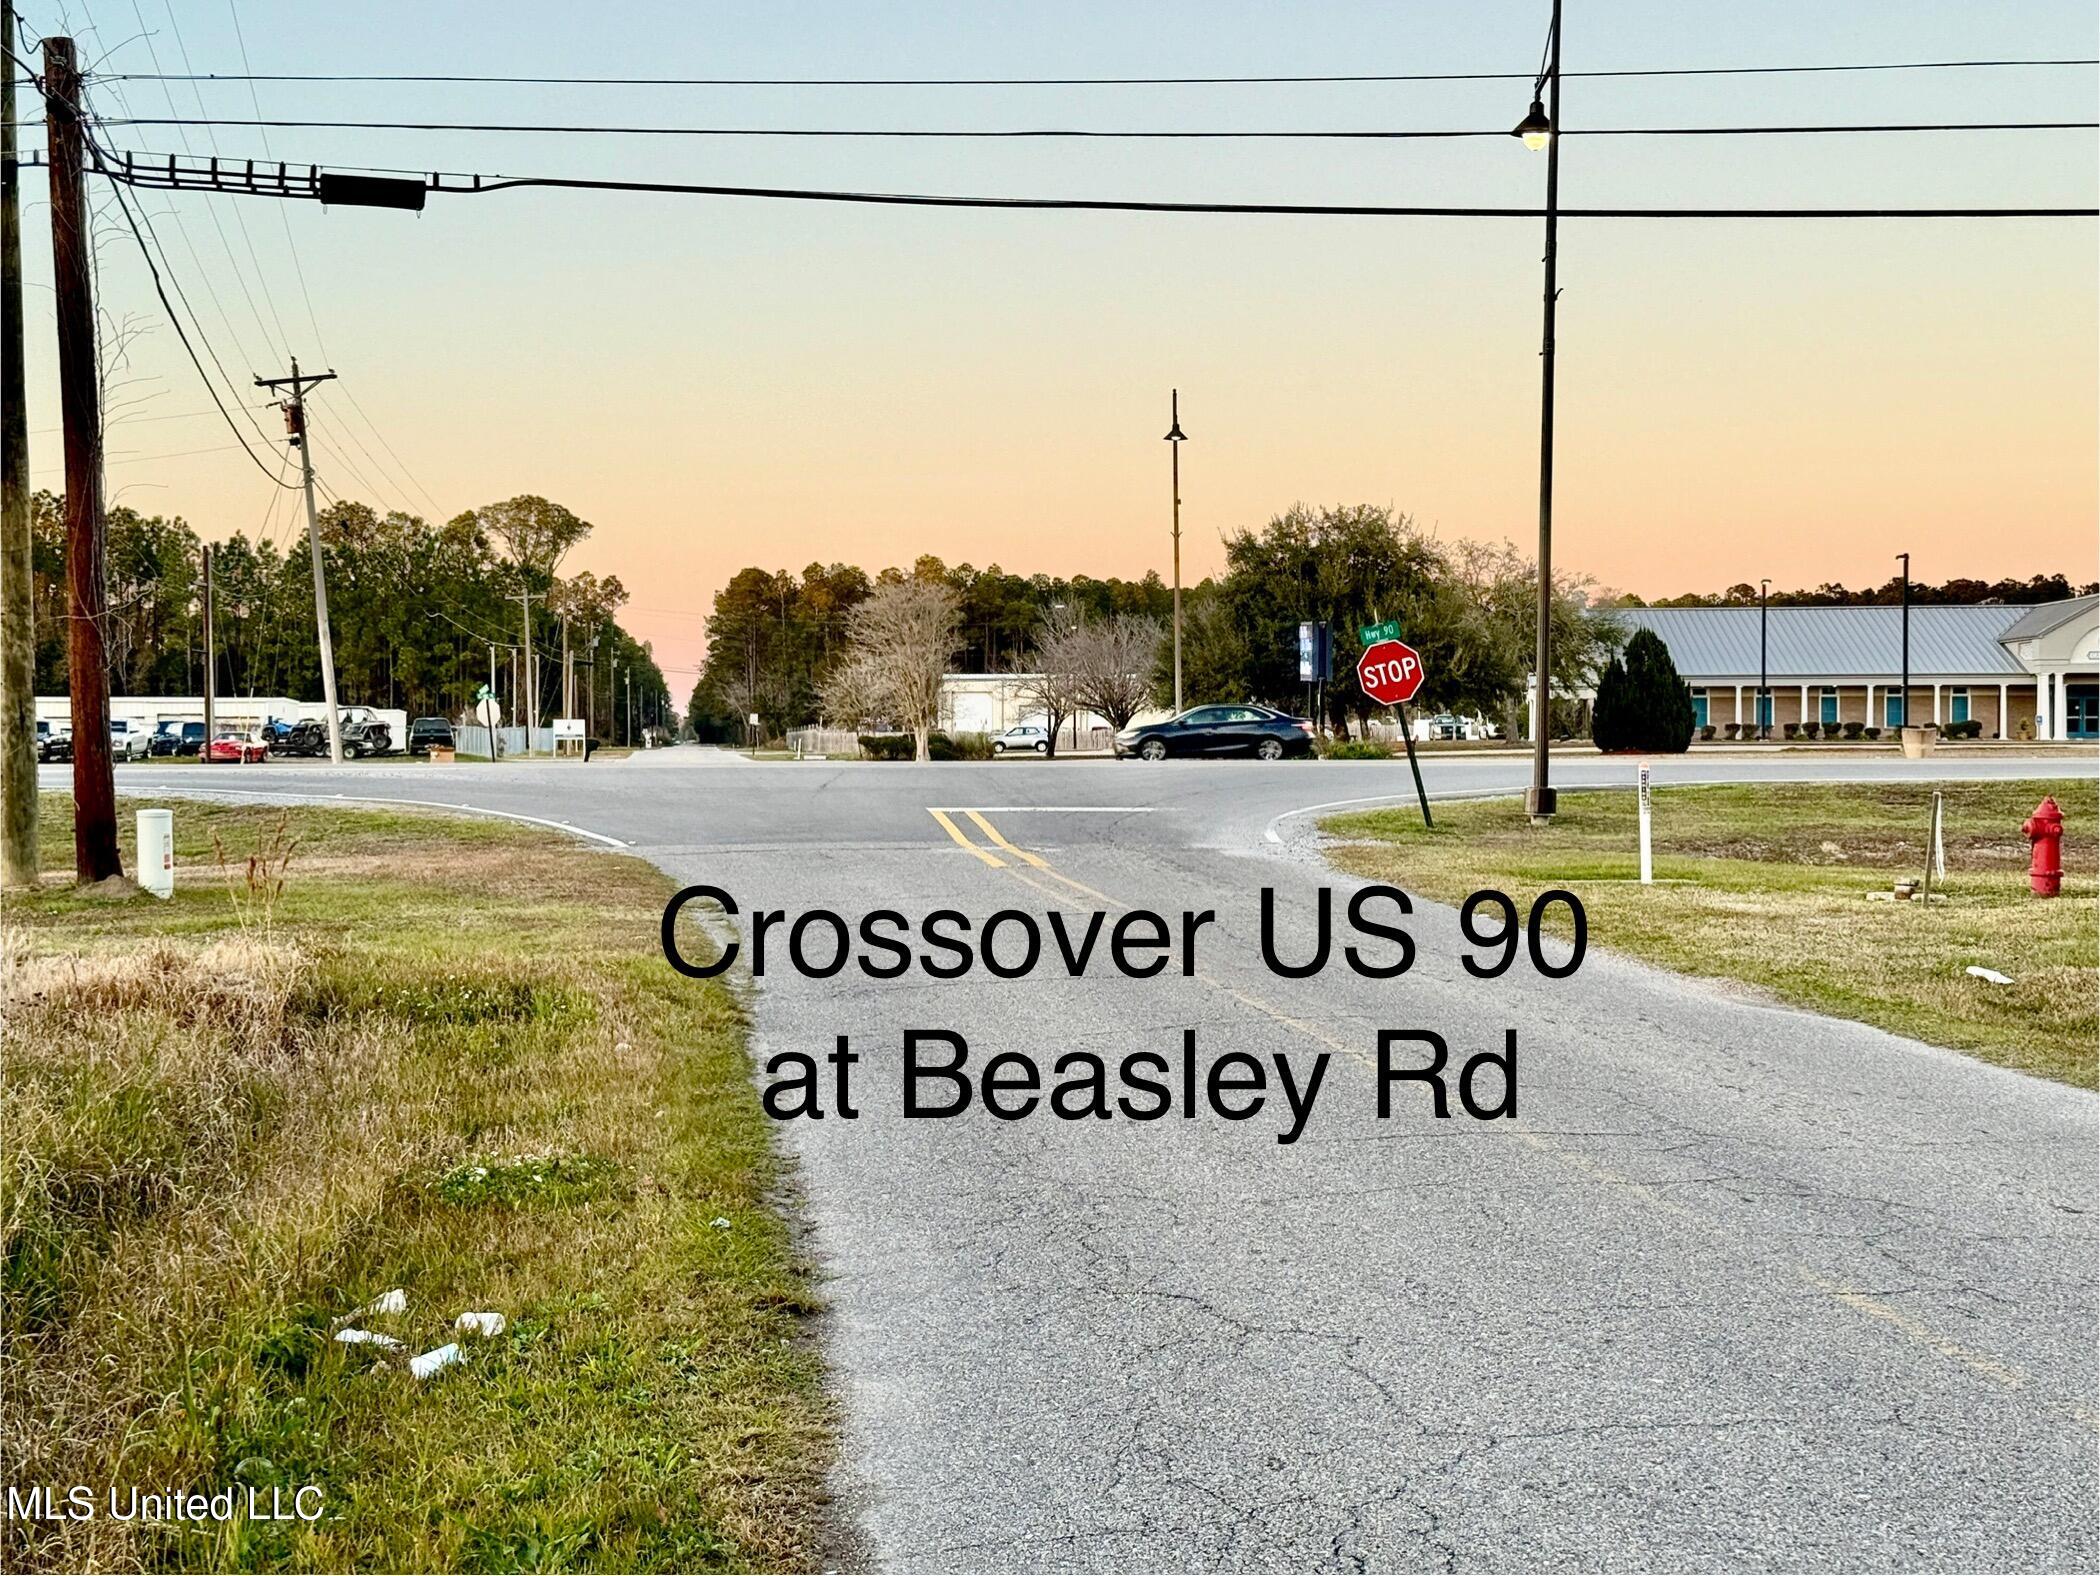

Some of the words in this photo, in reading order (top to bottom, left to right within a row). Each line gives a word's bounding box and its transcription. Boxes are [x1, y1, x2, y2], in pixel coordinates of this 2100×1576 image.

[1364, 629, 1380, 641] Hwy
[1383, 624, 1394, 636] 90
[1363, 656, 1416, 689] STOP
